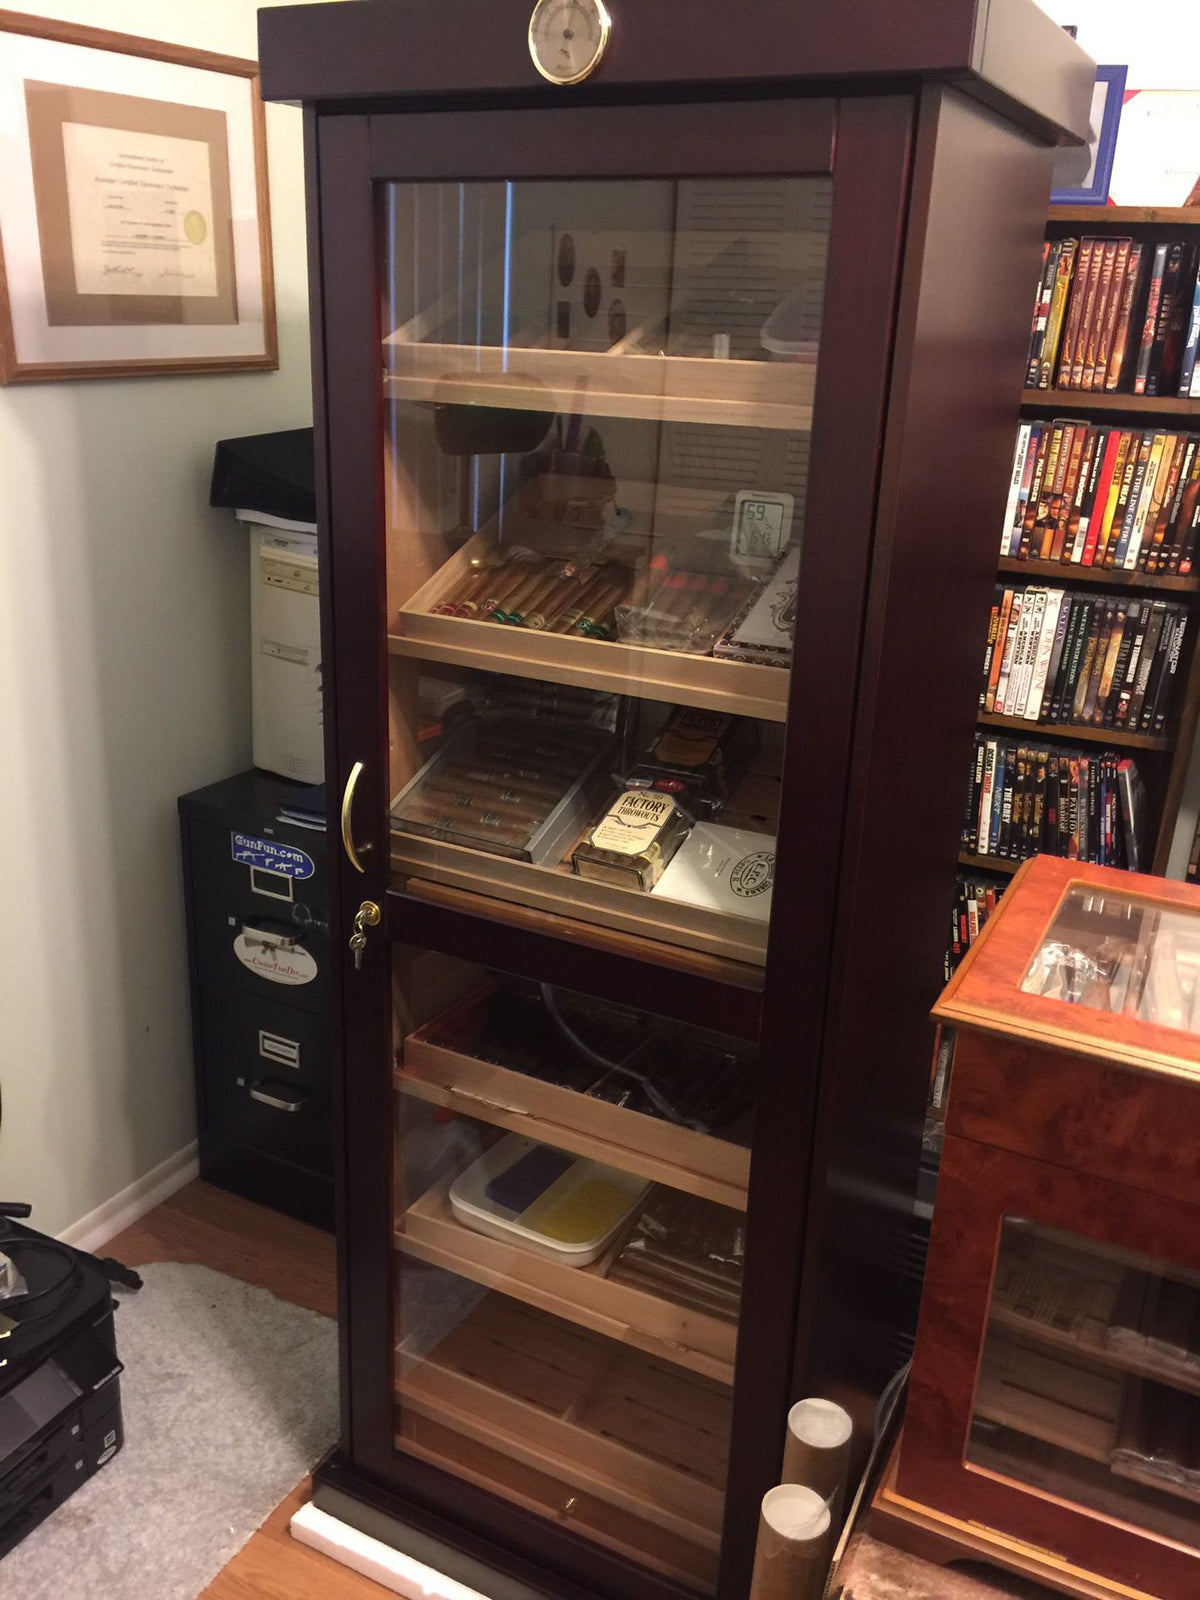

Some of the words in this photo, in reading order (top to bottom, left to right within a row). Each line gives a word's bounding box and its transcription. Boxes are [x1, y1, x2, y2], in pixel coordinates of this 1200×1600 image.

[1016, 454, 1025, 468] JOSEY
[1035, 459, 1045, 477] PALE
[1080, 462, 1089, 476] THE
[1136, 466, 1145, 475] IN
[1123, 465, 1134, 484] CITY
[1132, 478, 1142, 493] THE
[1030, 478, 1041, 502] RIDER
[1074, 476, 1086, 507] ROOKIE
[1118, 484, 1130, 506] HEAT
[747, 503, 766, 521] 59
[1128, 495, 1138, 512] LINE
[1124, 514, 1133, 525] OF
[1120, 526, 1130, 544] FIRE
[1055, 605, 1069, 641] MATRIX
[1078, 606, 1089, 635] MATRIX
[1013, 631, 1024, 665] WESTERN
[1018, 631, 1028, 665] AMERICAN
[1025, 631, 1035, 665] WESTERN
[1029, 631, 1040, 665] AMERICAN
[1040, 629, 1055, 656] JOHN
[1117, 640, 1131, 662] TOTAL
[1134, 635, 1144, 646] THE
[1169, 616, 1188, 675] TERMINATOR
[983, 646, 993, 670] HEROES
[1125, 647, 1141, 683] TERMINATOR
[1034, 660, 1049, 690] WAYNE
[1111, 664, 1126, 691] RECALL
[985, 748, 994, 772] OCEAN'S
[983, 773, 992, 794] TWELVE
[1003, 787, 1013, 802] THE
[622, 796, 670, 814] FACTORY
[993, 786, 1002, 814] NEXT
[617, 806, 661, 822] THROWOUTS
[1001, 803, 1011, 823] GREY
[234, 834, 304, 864] GunFun.com
